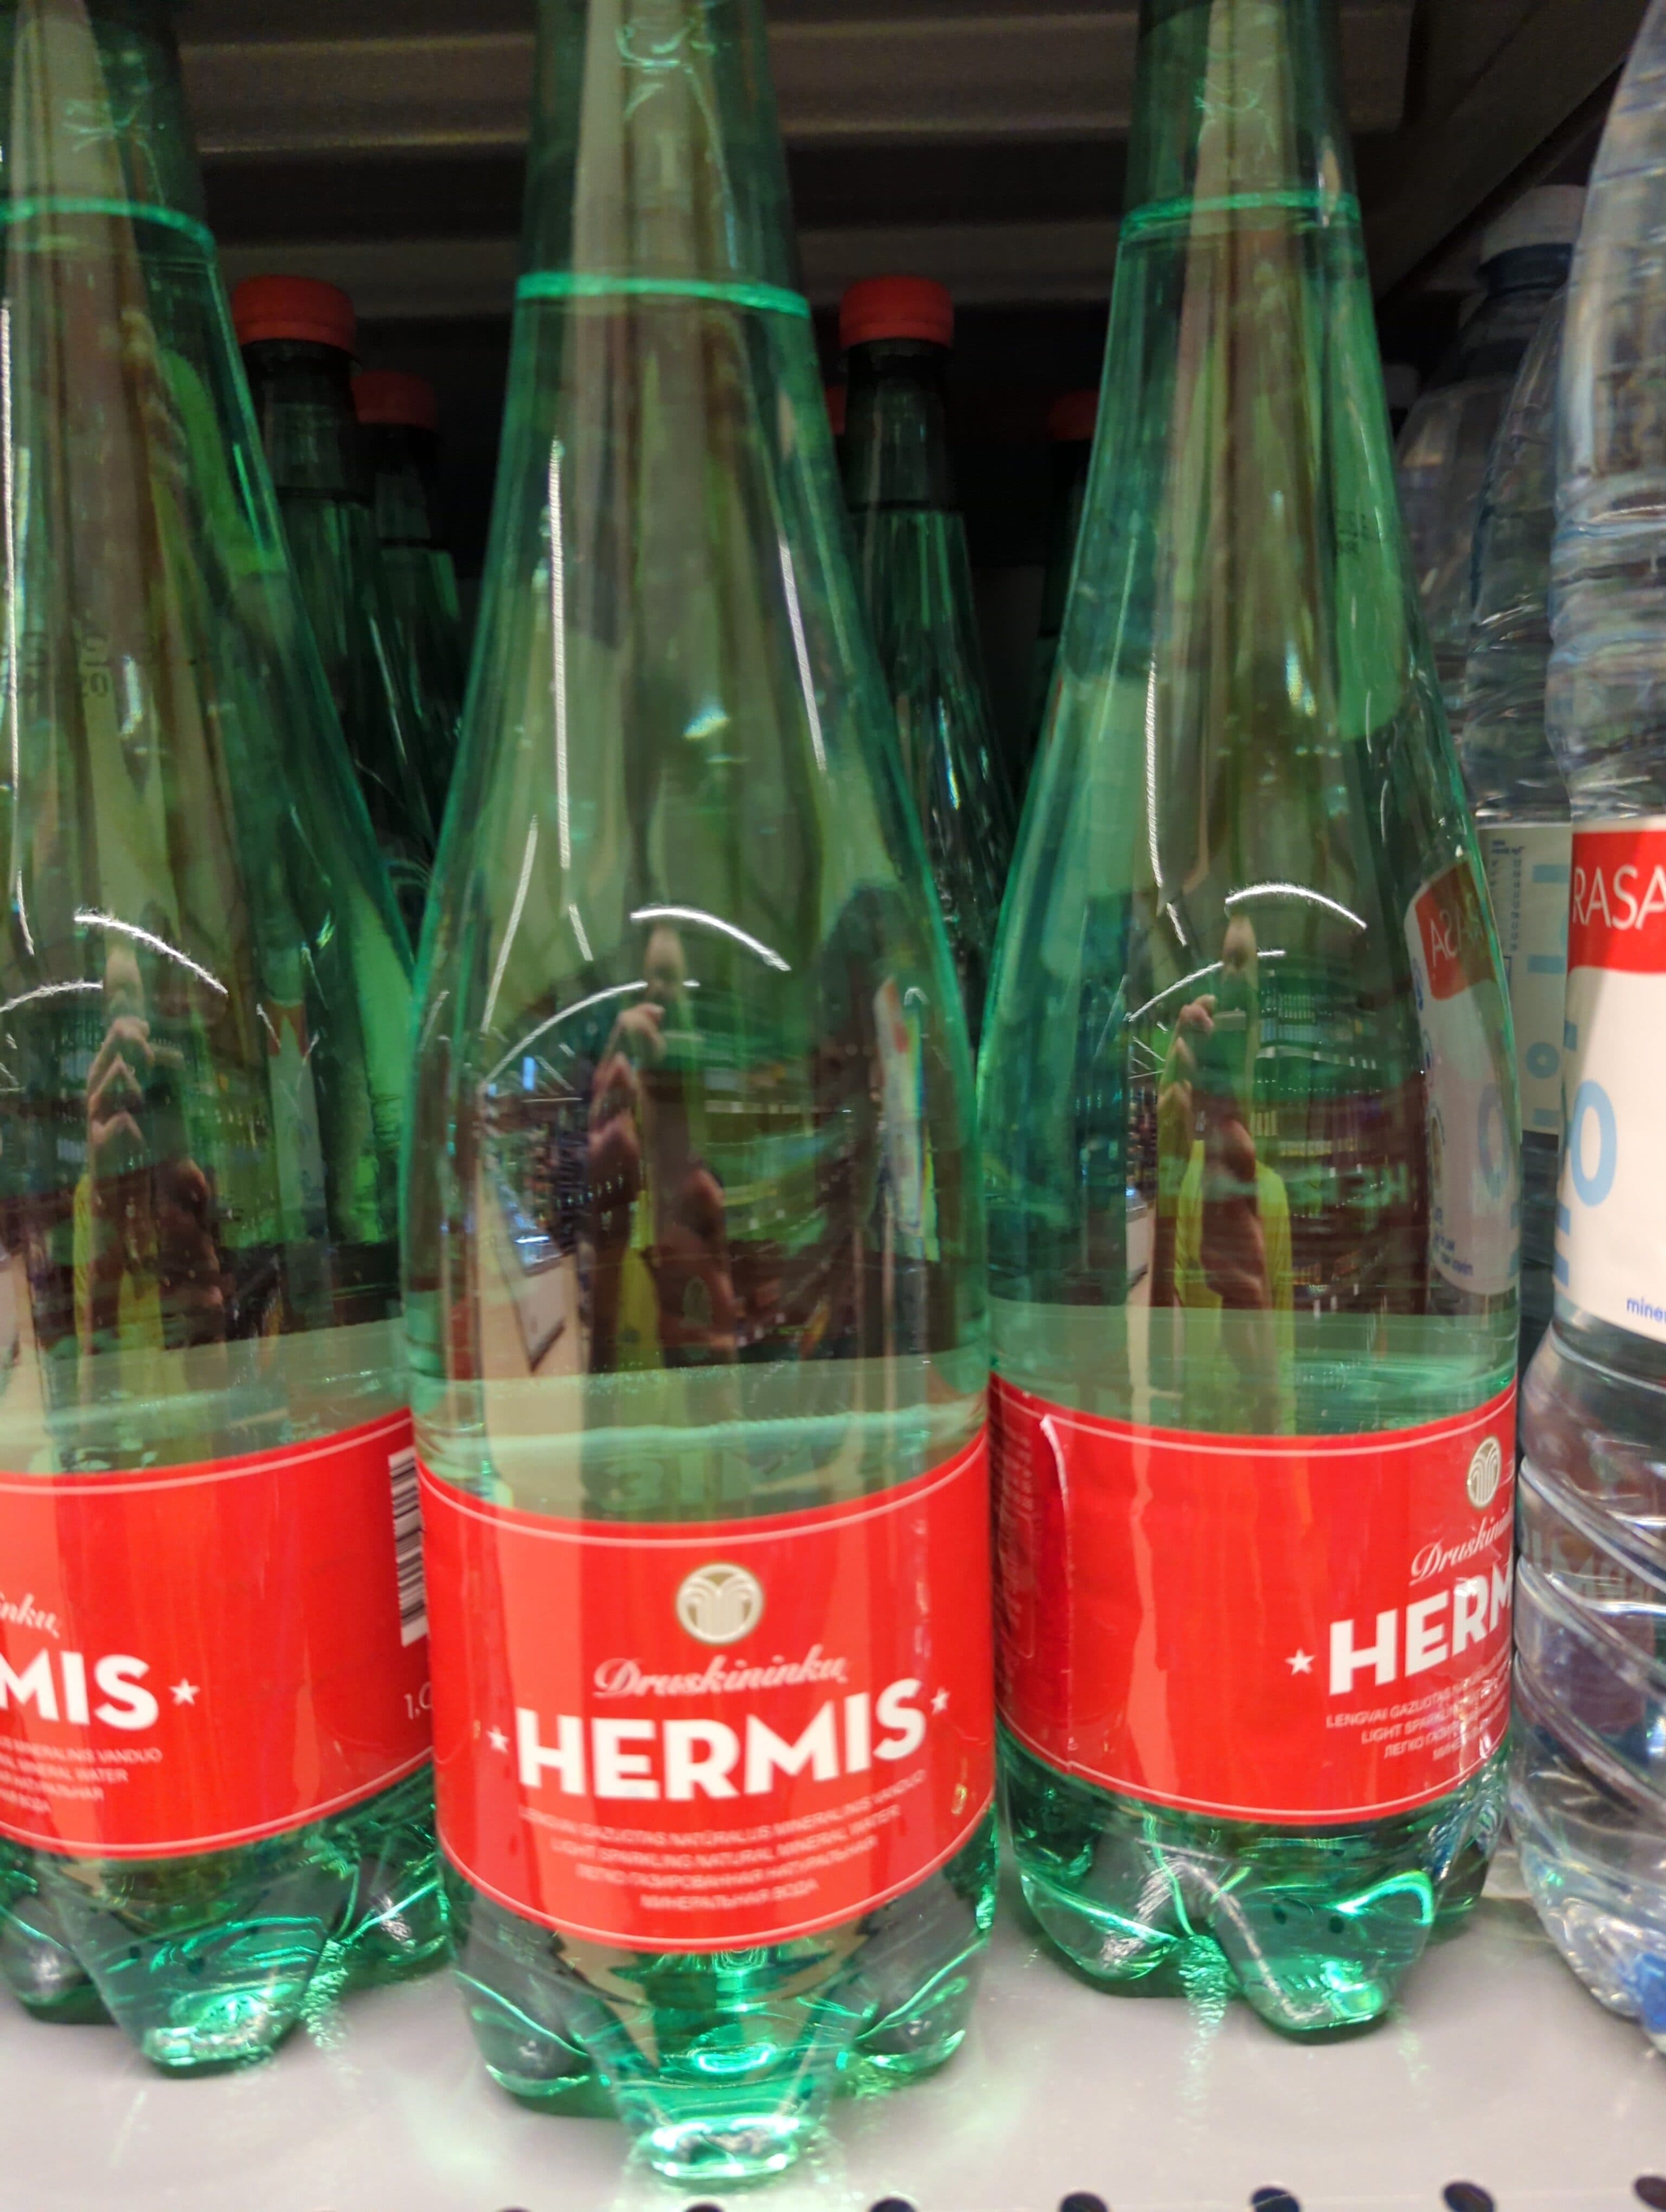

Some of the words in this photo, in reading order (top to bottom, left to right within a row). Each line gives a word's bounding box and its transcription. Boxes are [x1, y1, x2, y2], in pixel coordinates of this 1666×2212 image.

[1573, 863, 1666, 931] RASA
[1626, 1296, 1666, 1324] mine
[516, 1677, 926, 1801] HERMIS
[1361, 1721, 1404, 1744] LIGHT
[95, 1746, 163, 1764] VANDUO
